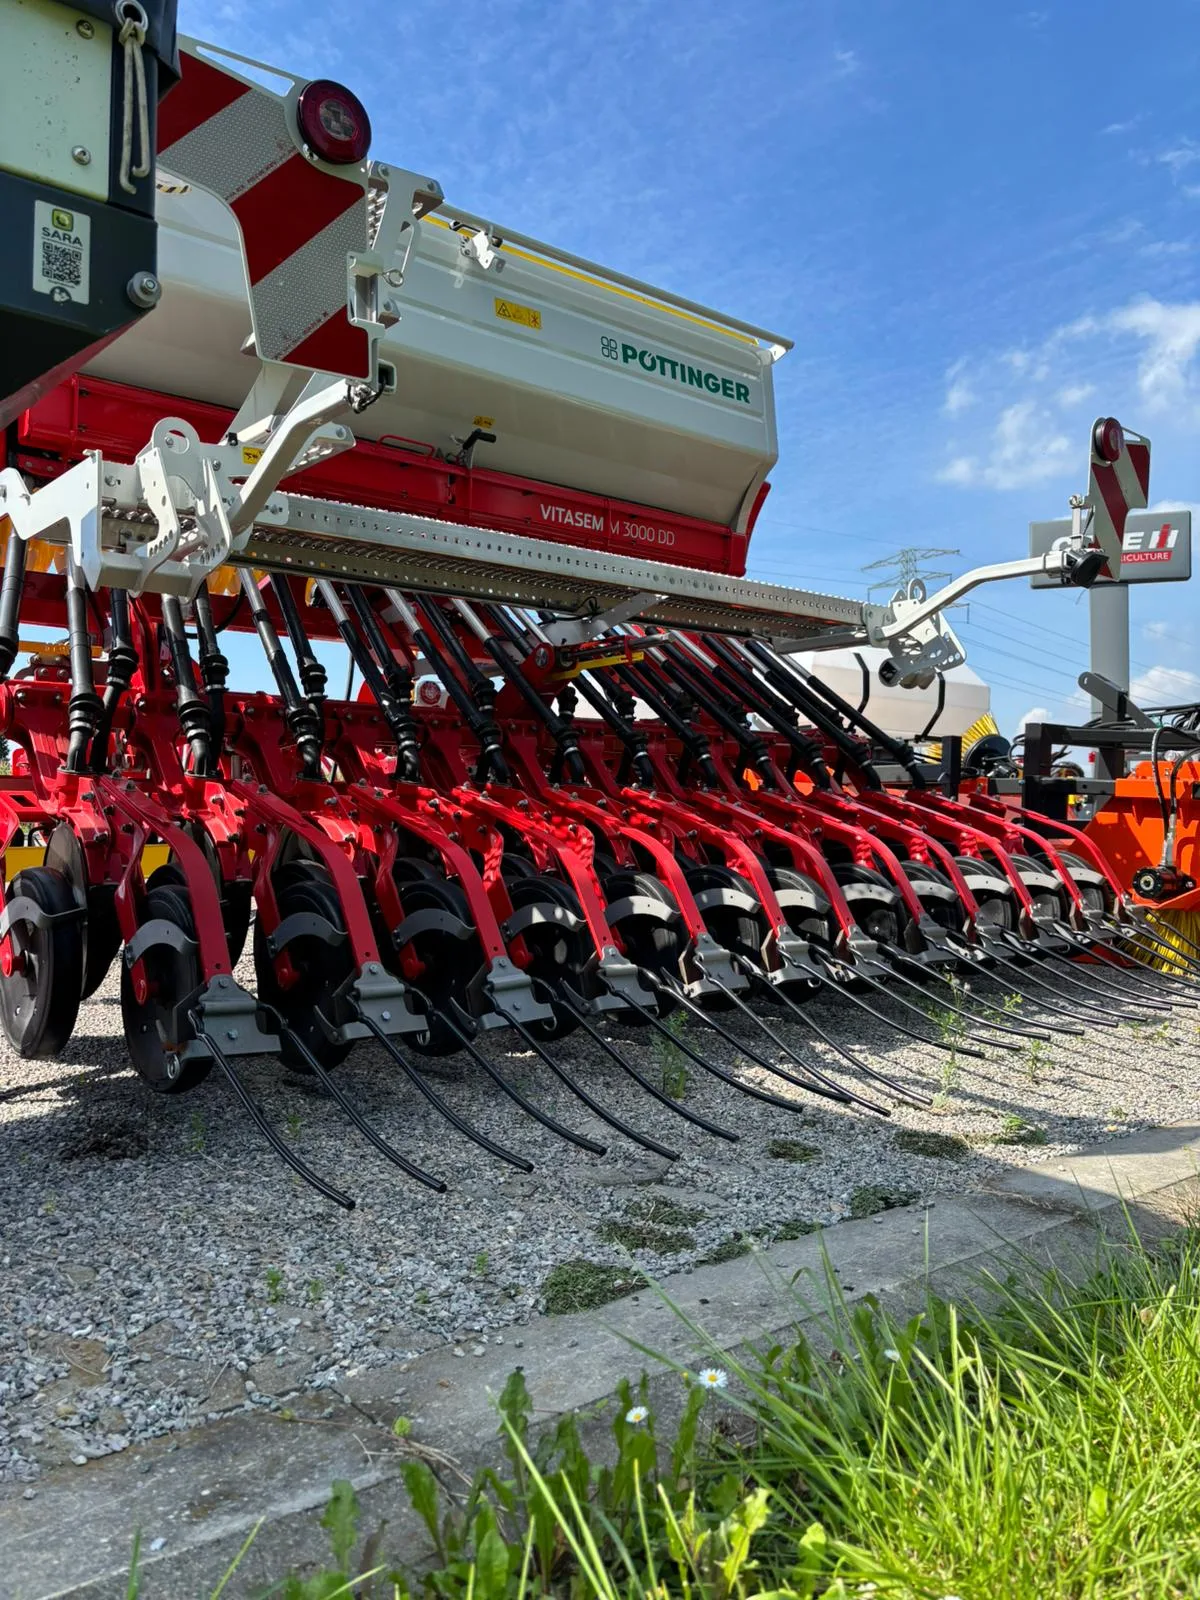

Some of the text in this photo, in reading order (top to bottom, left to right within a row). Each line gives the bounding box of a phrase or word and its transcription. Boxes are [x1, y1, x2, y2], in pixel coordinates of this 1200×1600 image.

[42, 226, 83, 247] SARA
[540, 503, 675, 546] VITASEM M 3000 DD
[1120, 552, 1169, 562] ICULTURE
